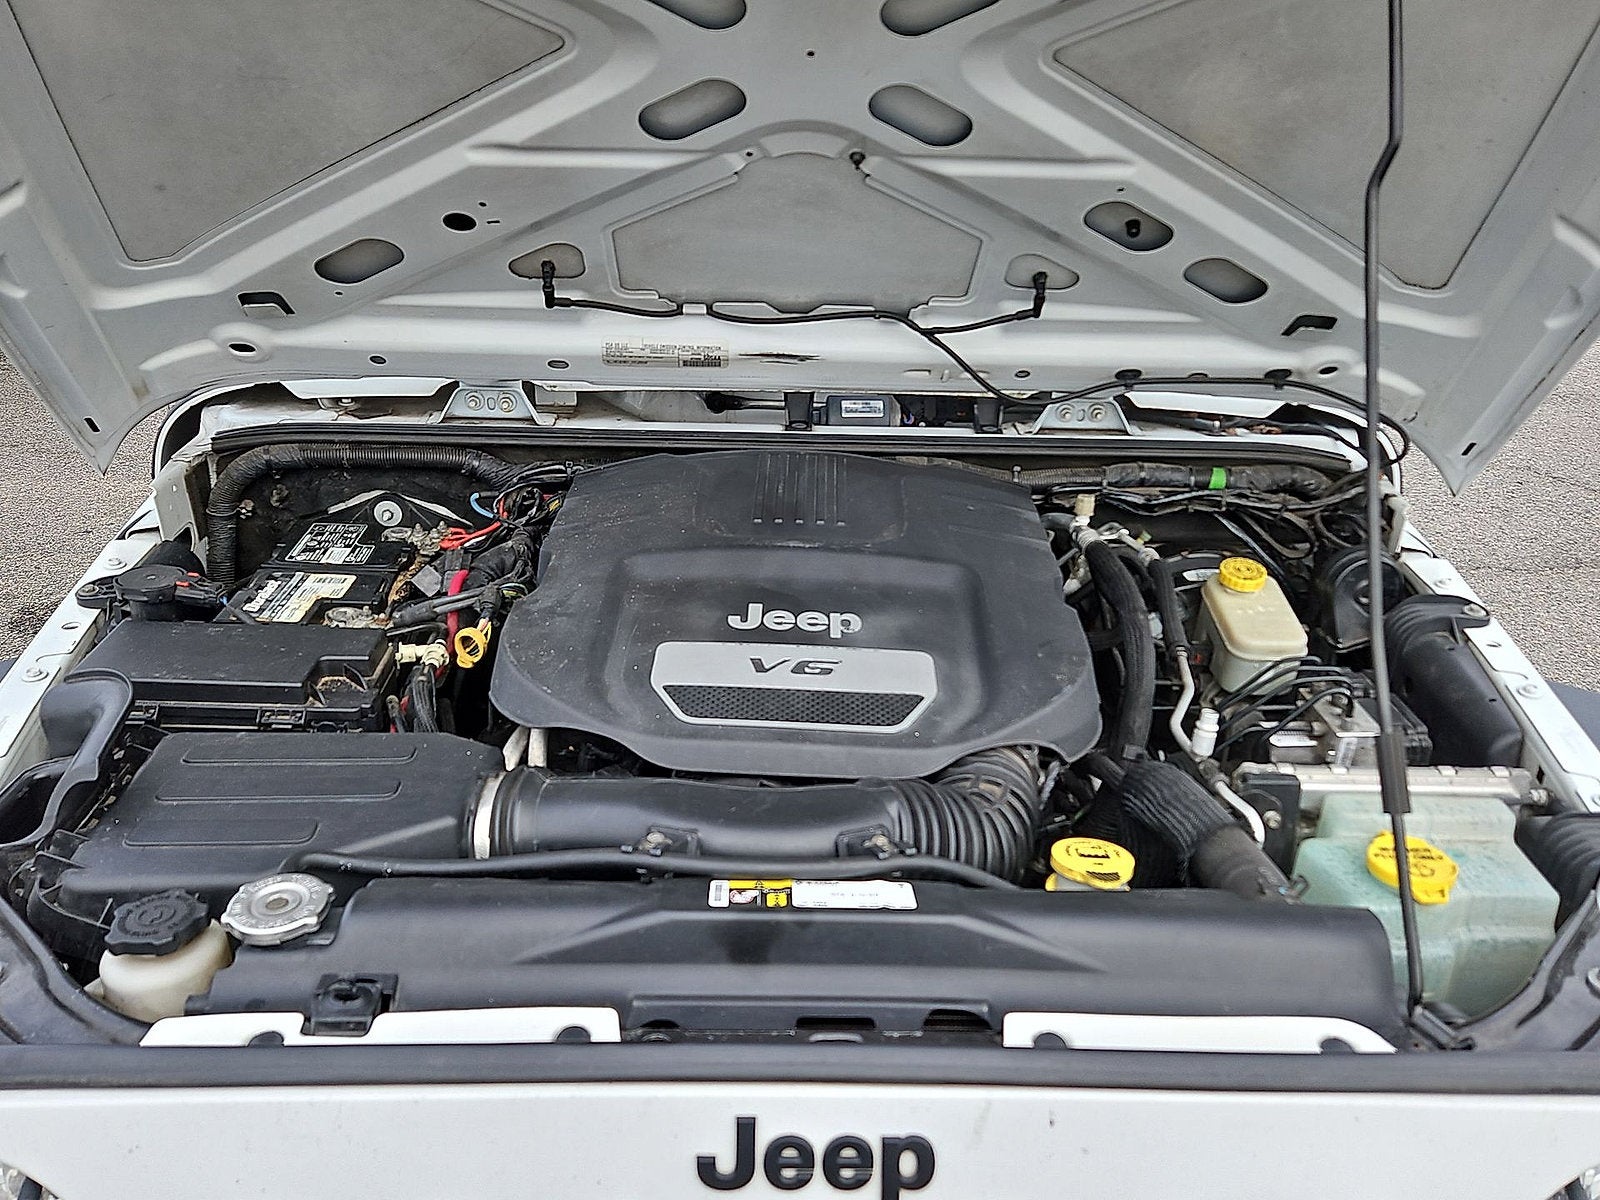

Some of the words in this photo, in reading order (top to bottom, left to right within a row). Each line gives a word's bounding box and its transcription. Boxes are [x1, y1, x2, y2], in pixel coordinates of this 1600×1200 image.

[727, 602, 863, 638] Jeep
[749, 656, 843, 676] V6
[696, 1116, 936, 1200] Jeep
